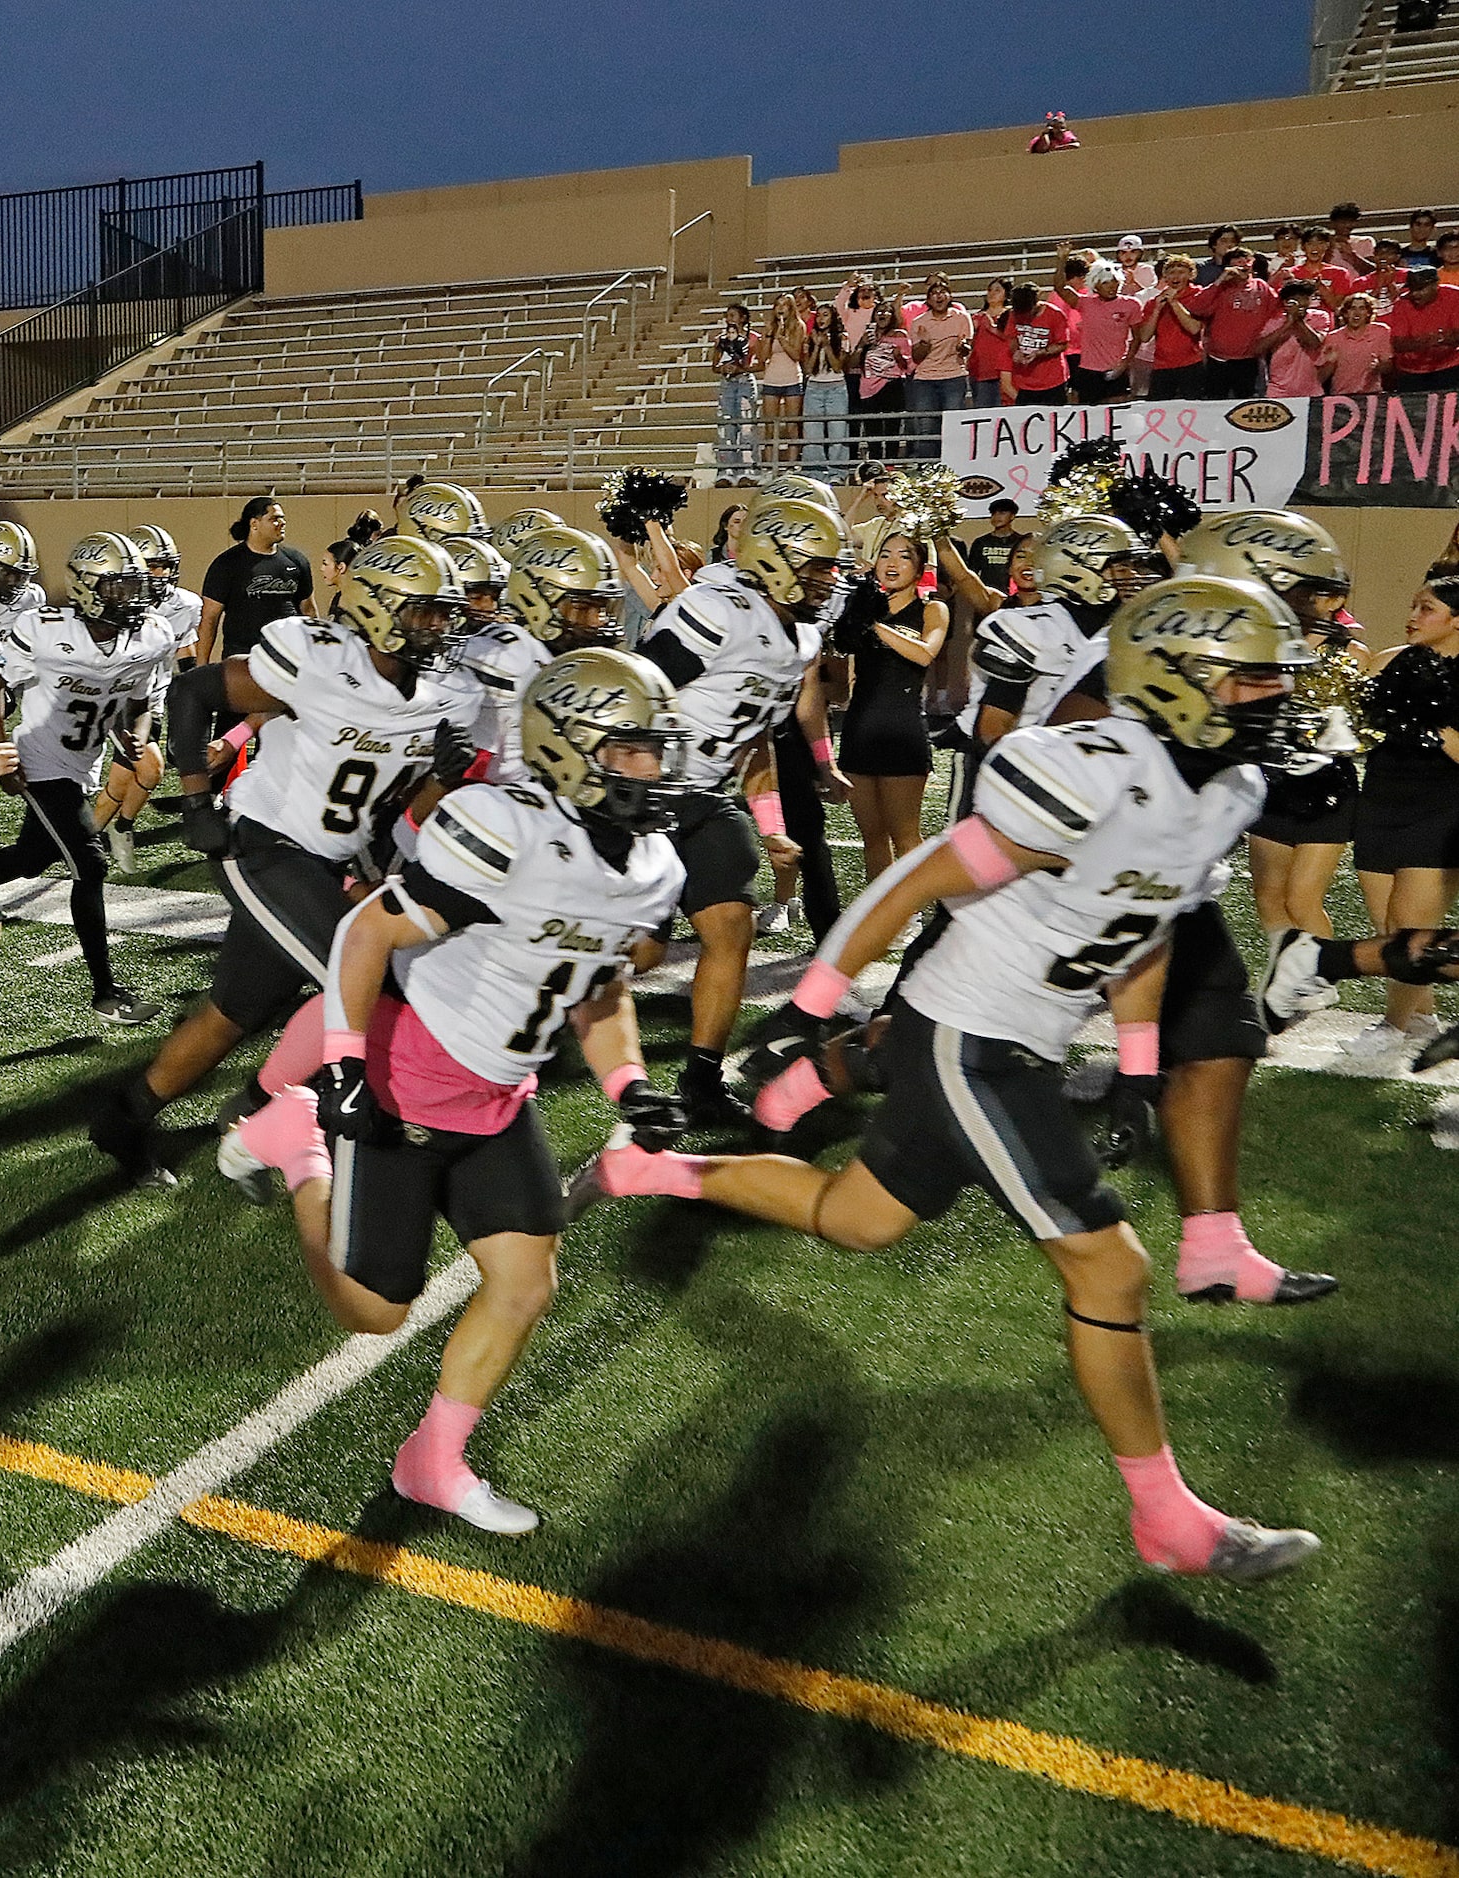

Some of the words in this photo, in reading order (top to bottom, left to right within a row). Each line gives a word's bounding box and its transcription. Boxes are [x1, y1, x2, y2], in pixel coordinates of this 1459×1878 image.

[1118, 446, 1259, 504] ANCER
[408, 494, 461, 522] East
[751, 508, 823, 542] East
[1222, 512, 1319, 560] East
[73, 545, 111, 564] ast
[1129, 592, 1254, 643] East
[53, 676, 102, 697] Plano
[108, 678, 136, 696] East
[331, 726, 392, 755] Plano
